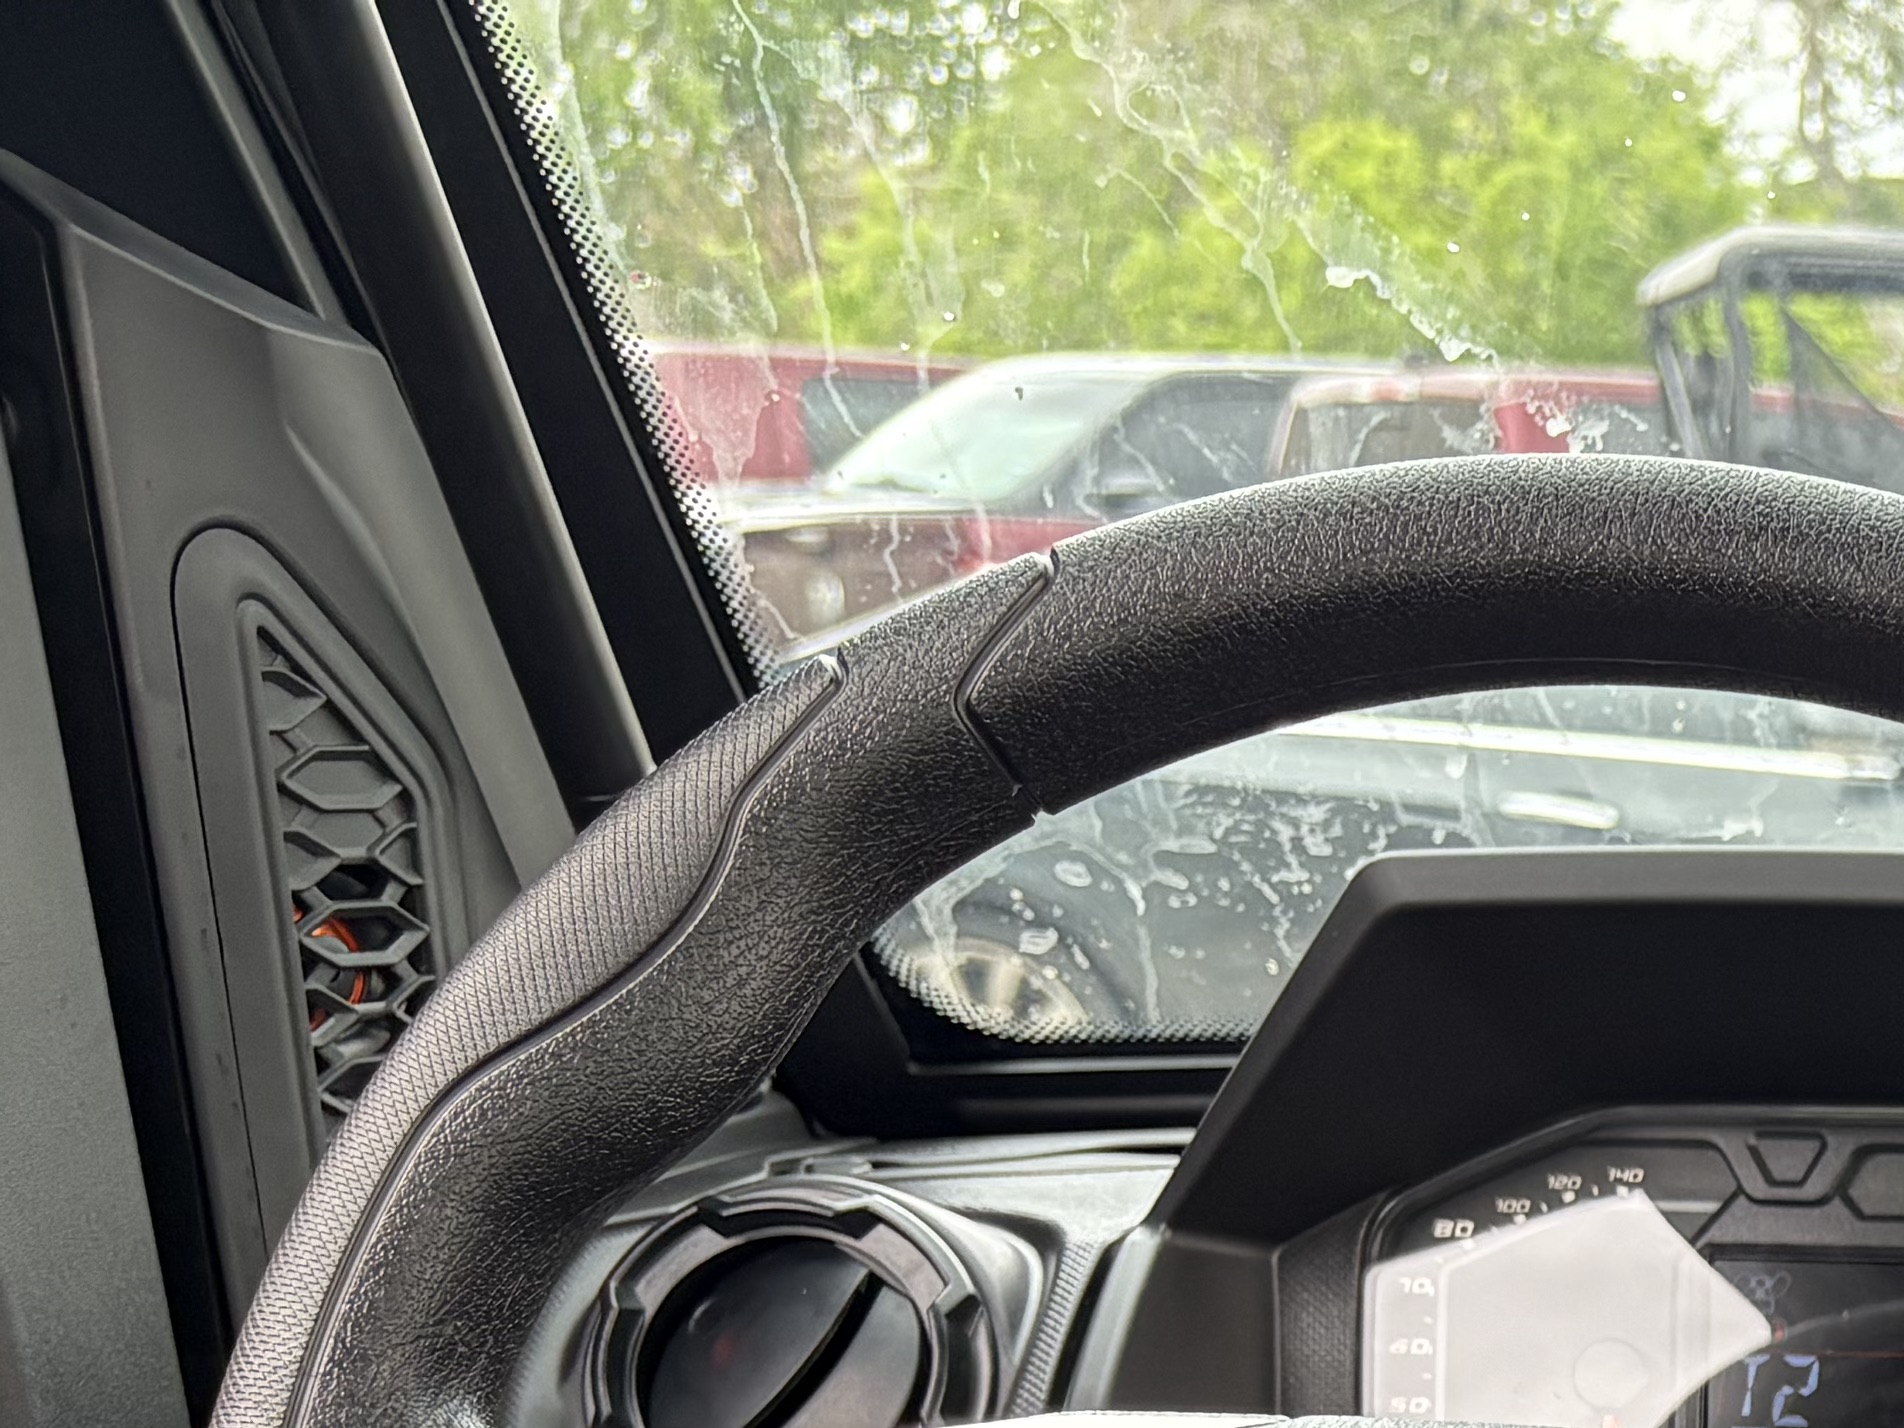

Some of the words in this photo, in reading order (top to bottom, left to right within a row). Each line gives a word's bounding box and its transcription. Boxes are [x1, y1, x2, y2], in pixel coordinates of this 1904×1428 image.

[1548, 1175, 1581, 1190] 120
[1608, 1167, 1644, 1183] 140
[1496, 1199, 1530, 1213] 100
[1433, 1219, 1474, 1237] 80
